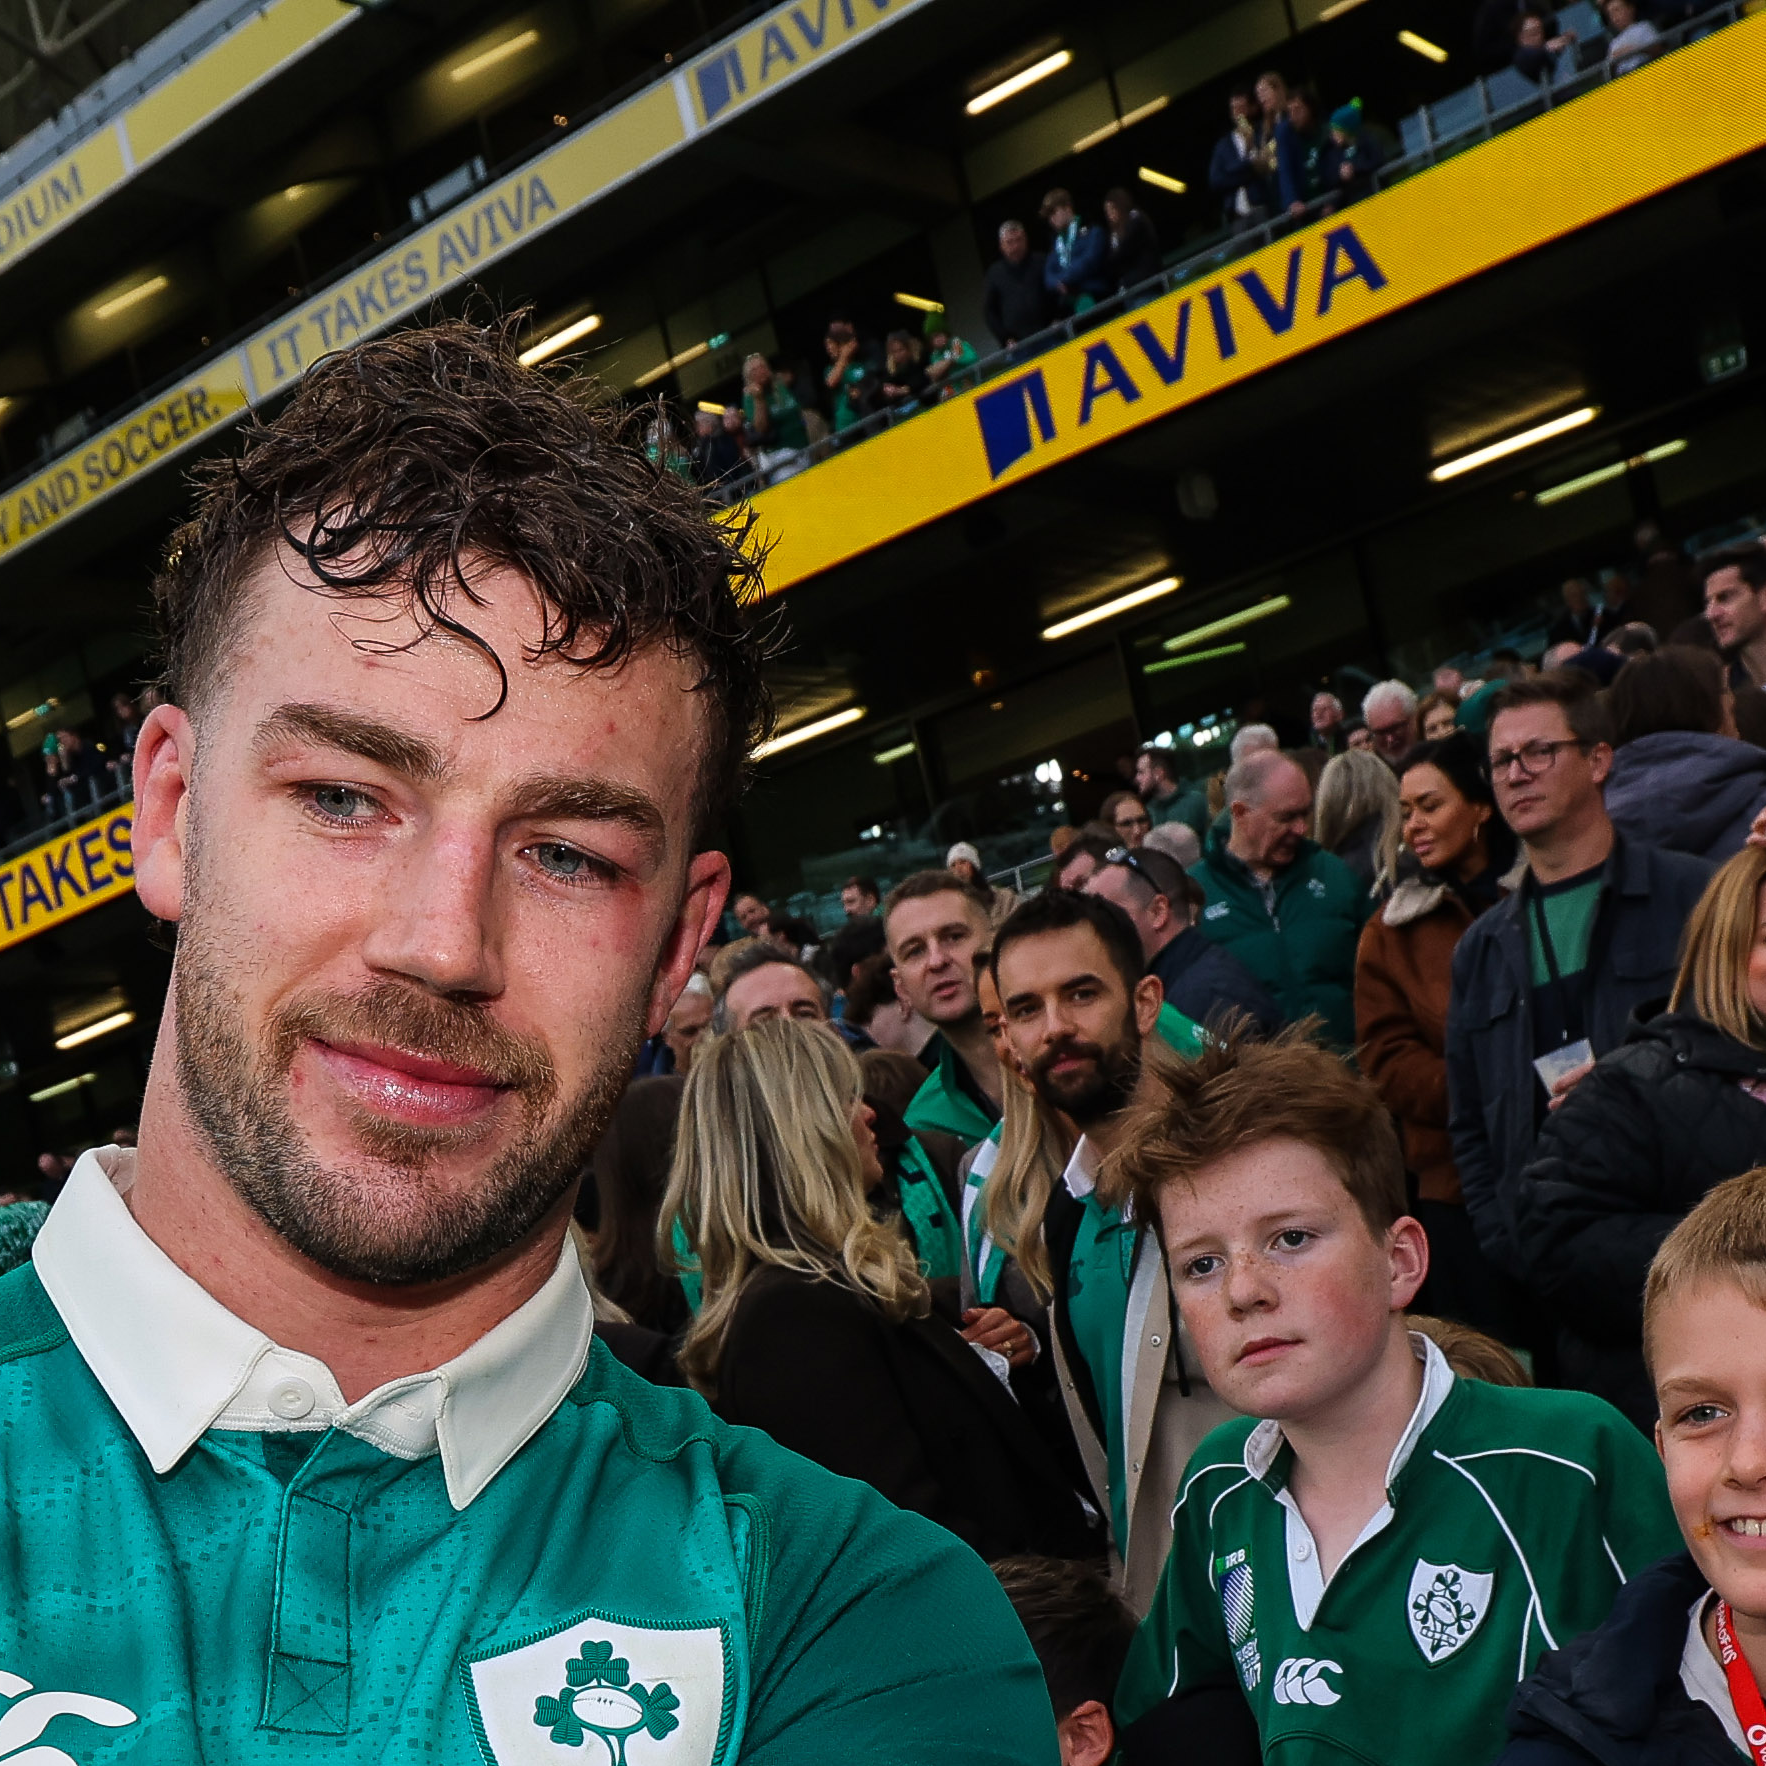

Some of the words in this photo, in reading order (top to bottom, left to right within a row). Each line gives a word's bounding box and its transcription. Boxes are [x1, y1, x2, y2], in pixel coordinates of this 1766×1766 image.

[761, 0, 892, 80] AVI
[19, 469, 81, 536] AND
[86, 386, 222, 493] SOCCER.
[264, 324, 311, 380] IT
[307, 250, 430, 349] TAKES
[437, 175, 557, 278] AVIVA
[1079, 224, 1388, 426] AVIVA
